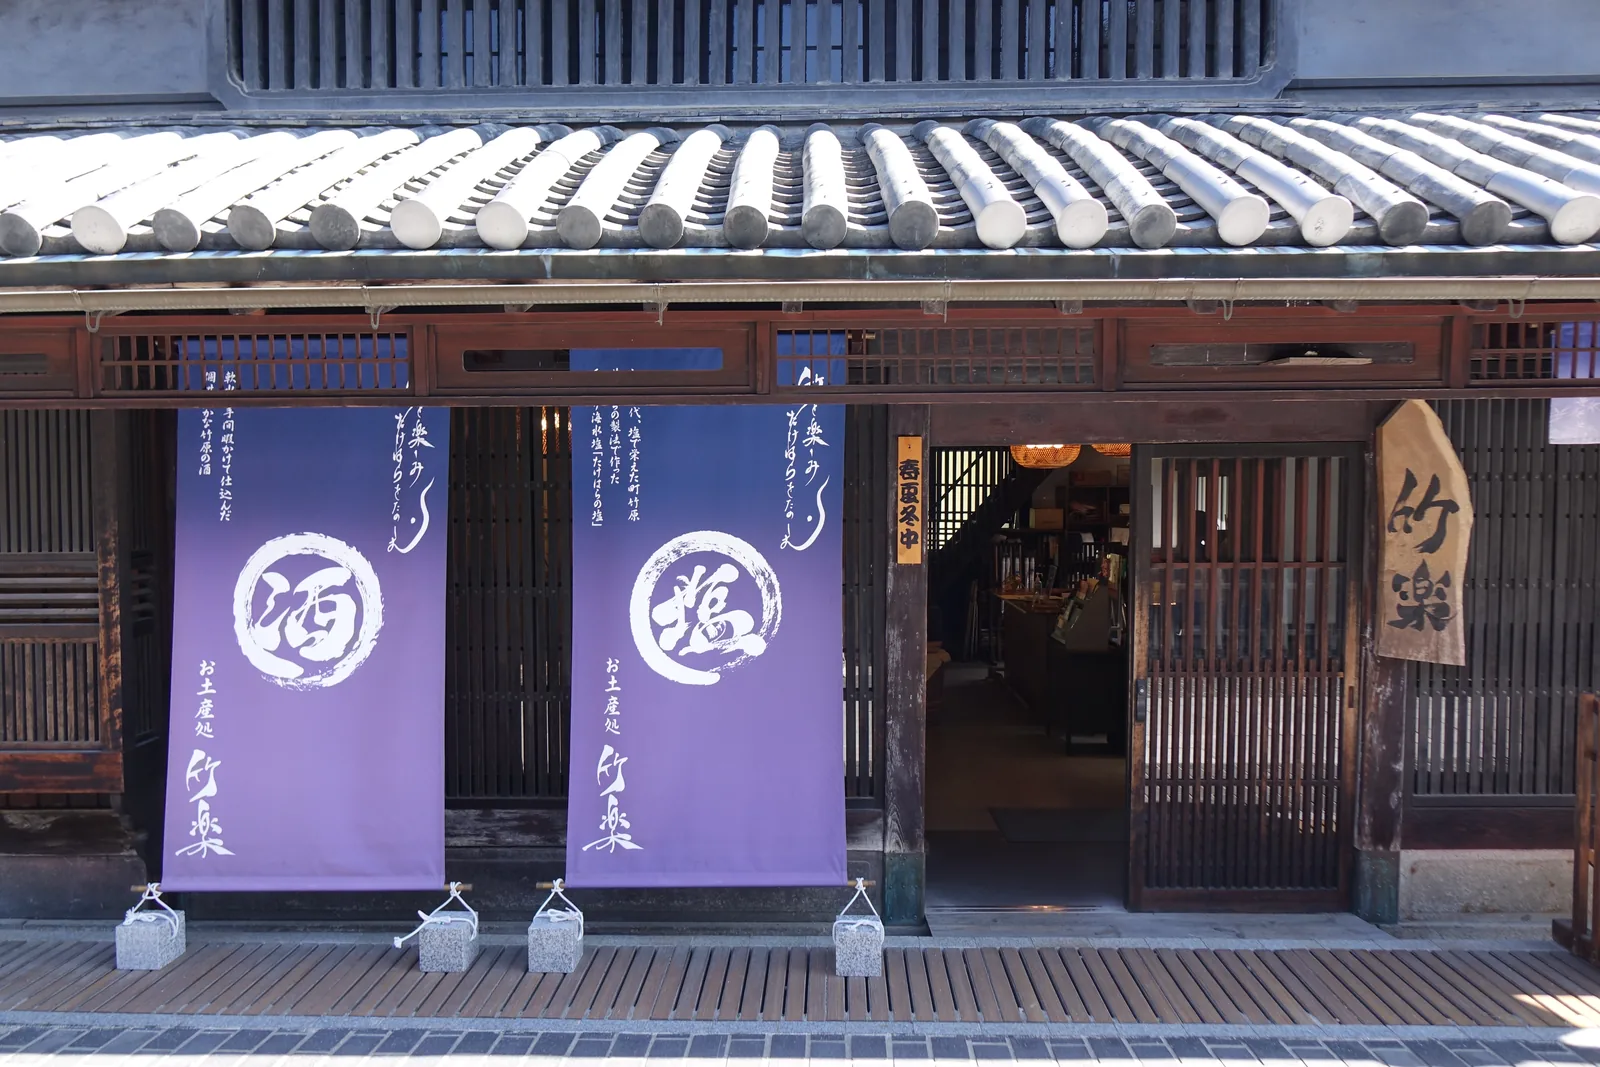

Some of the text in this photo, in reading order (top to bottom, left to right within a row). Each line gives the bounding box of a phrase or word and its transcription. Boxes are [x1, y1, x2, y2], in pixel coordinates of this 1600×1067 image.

[199, 371, 216, 476] 個かな竹原の酒
[219, 371, 237, 521] 軟手間暇かけて仕込んだ
[591, 368, 604, 527] 海水塩「たけはらの塩」
[609, 368, 622, 485] の製法で作った
[628, 368, 642, 522] 代、塩で栄えた町竹原
[250, 567, 357, 662] 酒
[651, 563, 767, 656] 塩
[1387, 467, 1460, 631] 竹楽
[175, 659, 236, 858] お土産処 竹楽
[581, 657, 645, 854] お土産処 竹楽
